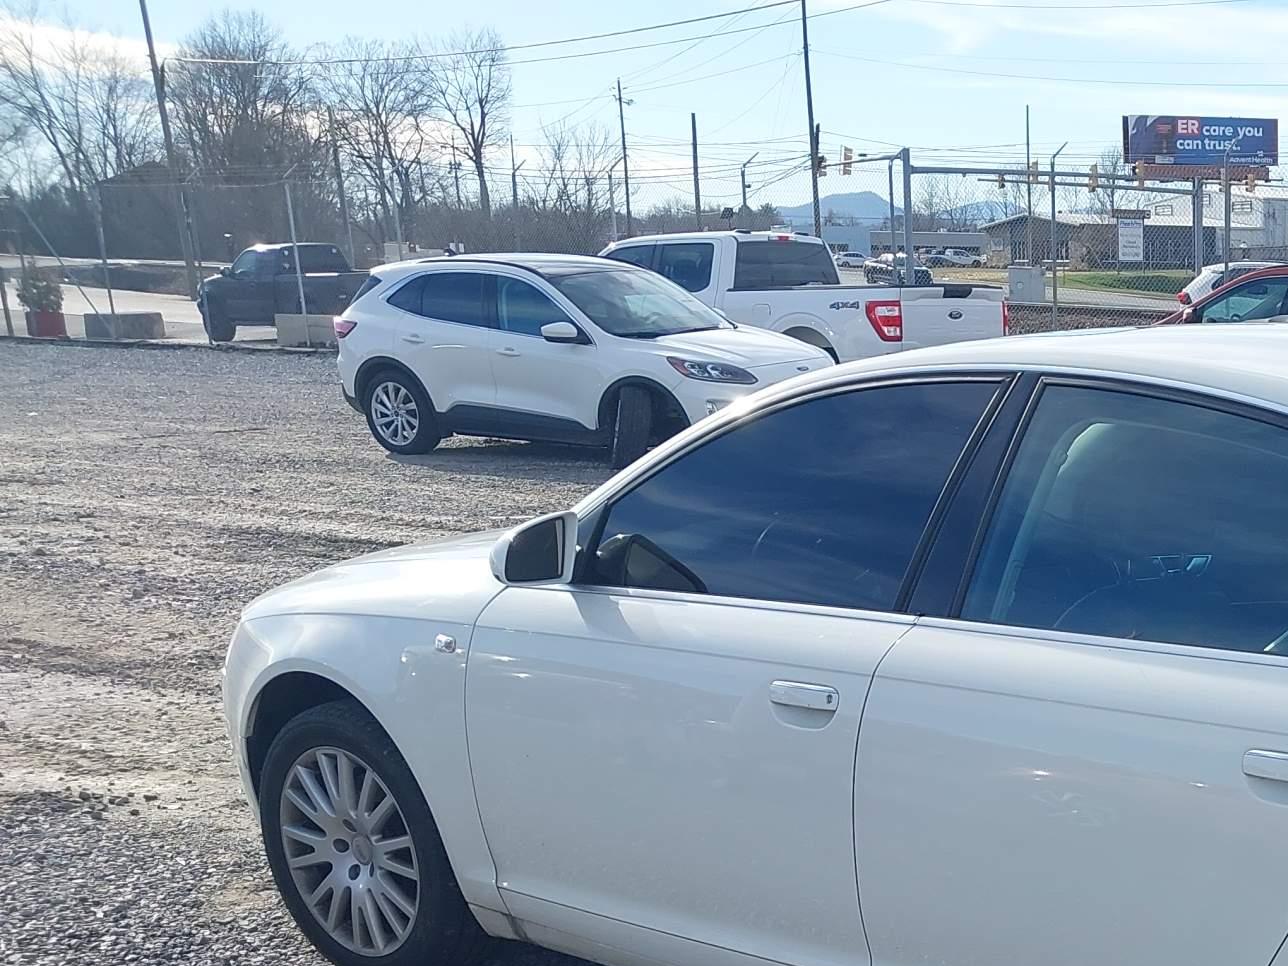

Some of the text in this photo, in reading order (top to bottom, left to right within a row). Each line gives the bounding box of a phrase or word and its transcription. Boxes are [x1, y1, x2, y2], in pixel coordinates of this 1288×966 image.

[1177, 119, 1263, 139] ER care you
[1176, 138, 1241, 151] can trust.
